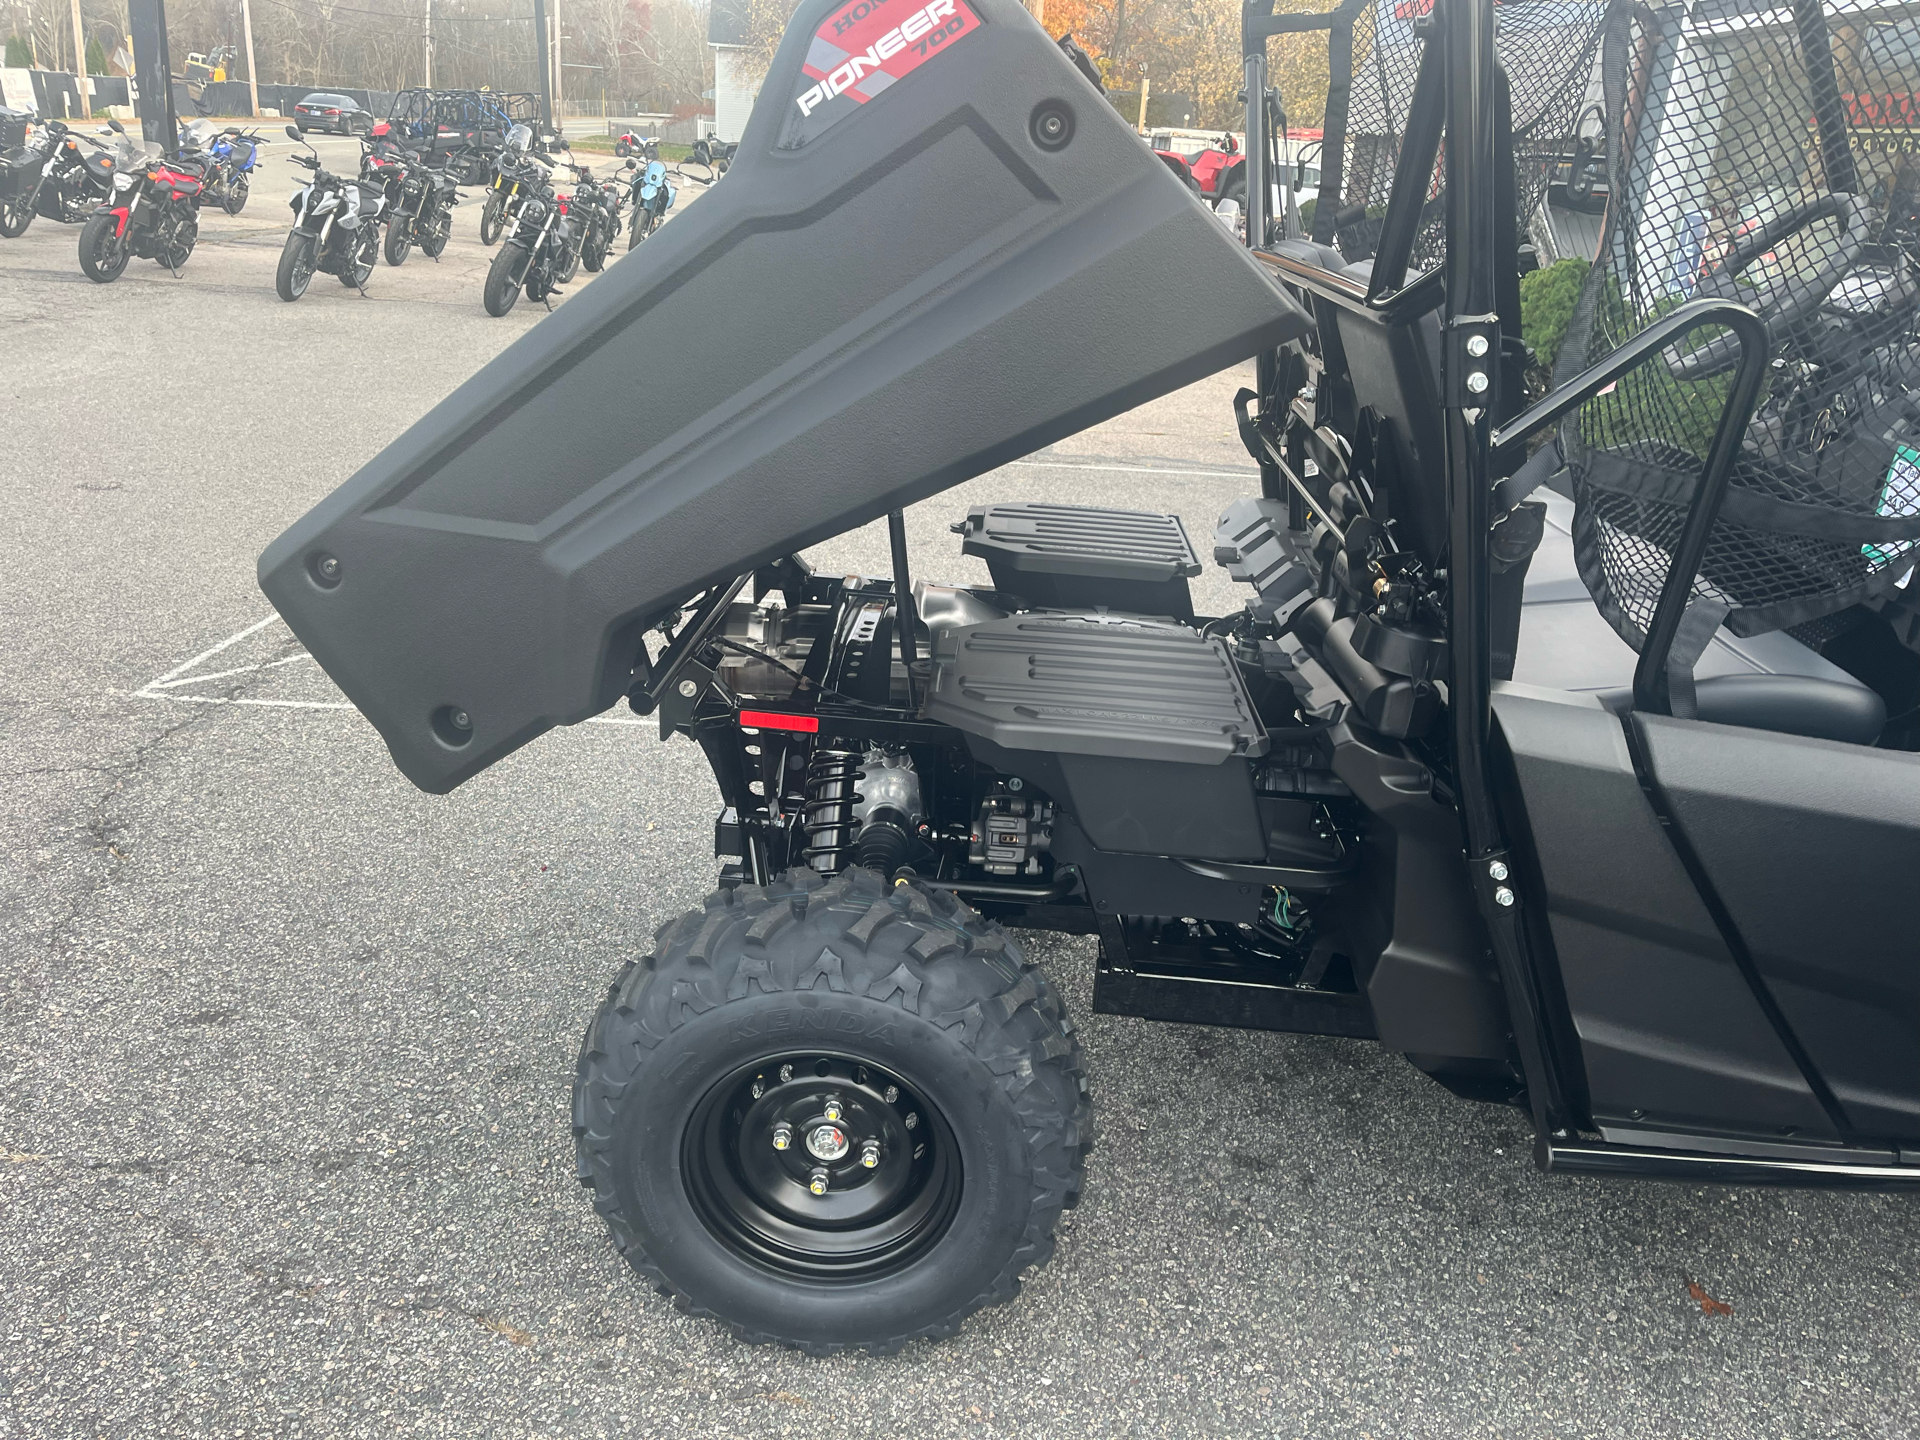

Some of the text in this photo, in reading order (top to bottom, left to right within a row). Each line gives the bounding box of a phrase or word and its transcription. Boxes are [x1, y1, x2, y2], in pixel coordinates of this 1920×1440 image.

[911, 16, 965, 57] 700
[796, 0, 957, 117] PIONEER
[1808, 91, 1920, 124] OND
[1801, 136, 1920, 154] GERATOR
[1077, 710, 1119, 718] LOAD
[726, 1007, 898, 1047] KENDA
